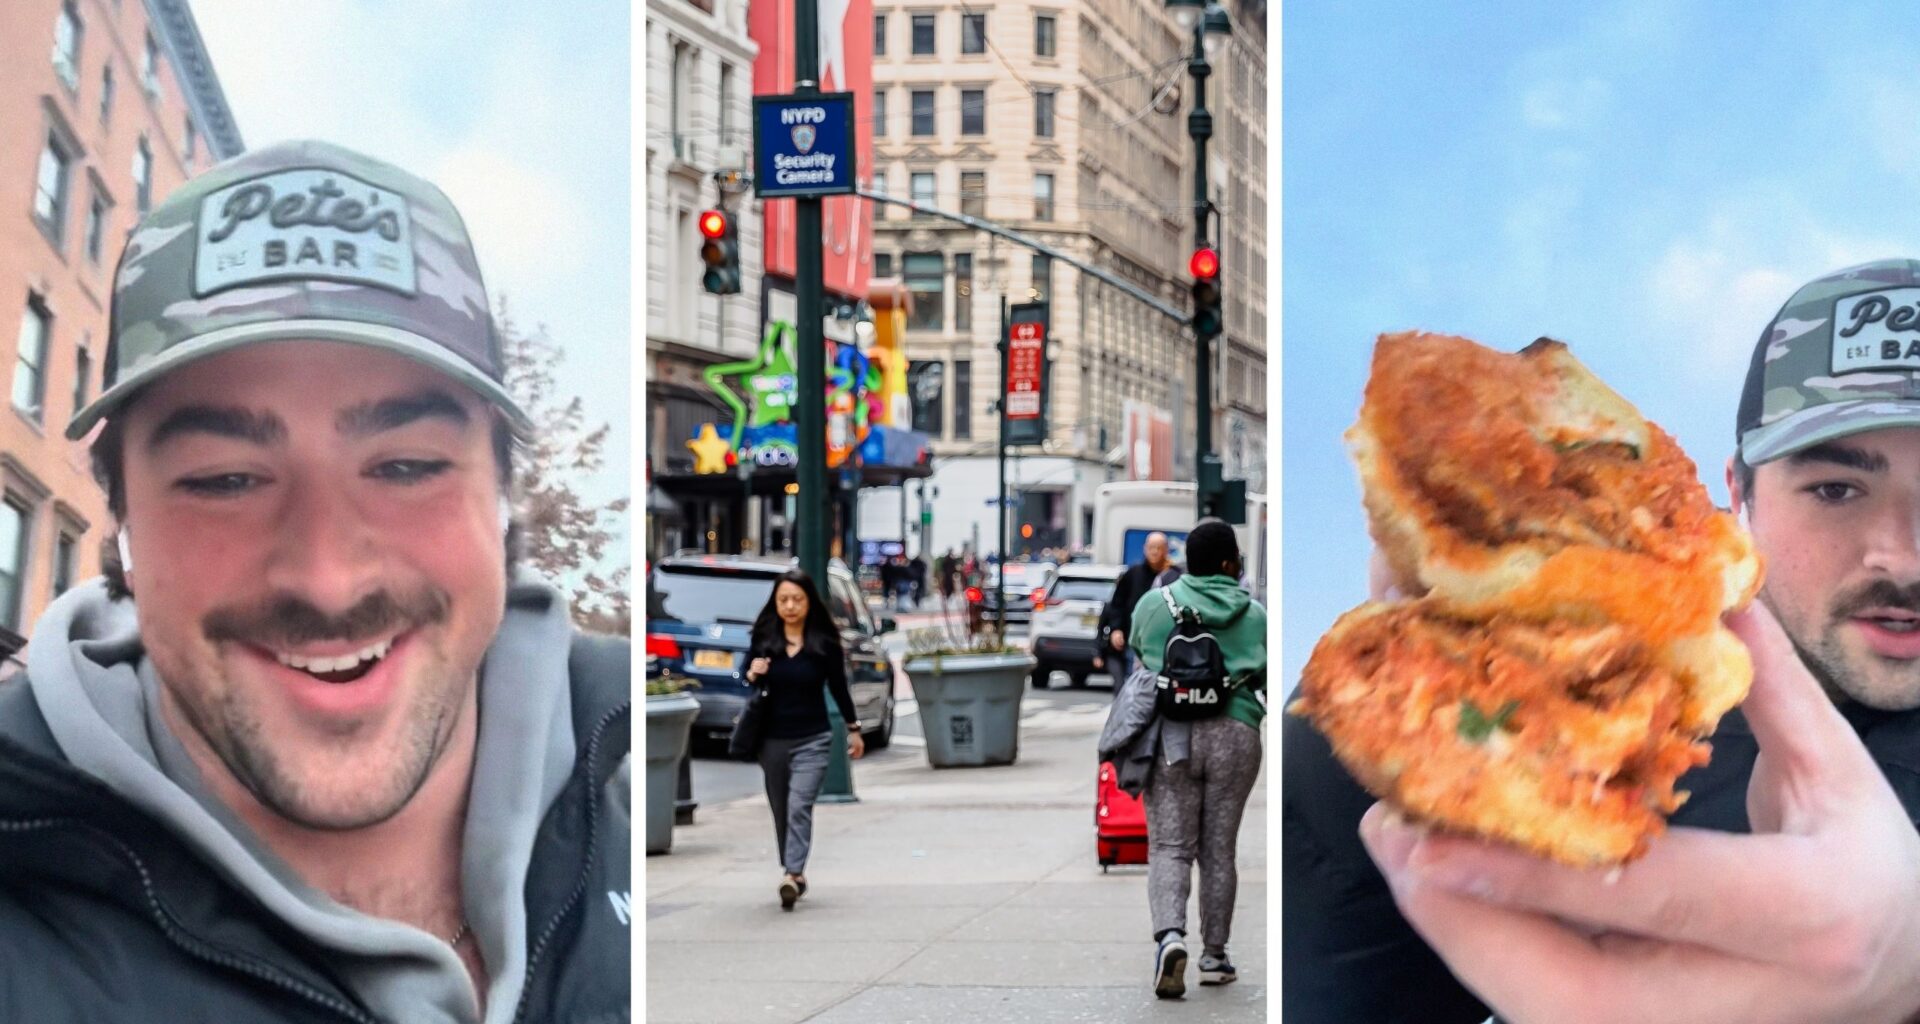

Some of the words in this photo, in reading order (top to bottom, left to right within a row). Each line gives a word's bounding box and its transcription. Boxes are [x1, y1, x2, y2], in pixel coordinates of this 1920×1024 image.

[781, 107, 826, 125] NYPD
[774, 152, 835, 170] Security
[776, 169, 834, 185] Camera
[207, 179, 400, 243] Pete's
[264, 237, 359, 268] BAR
[1175, 688, 1218, 704] FILA
